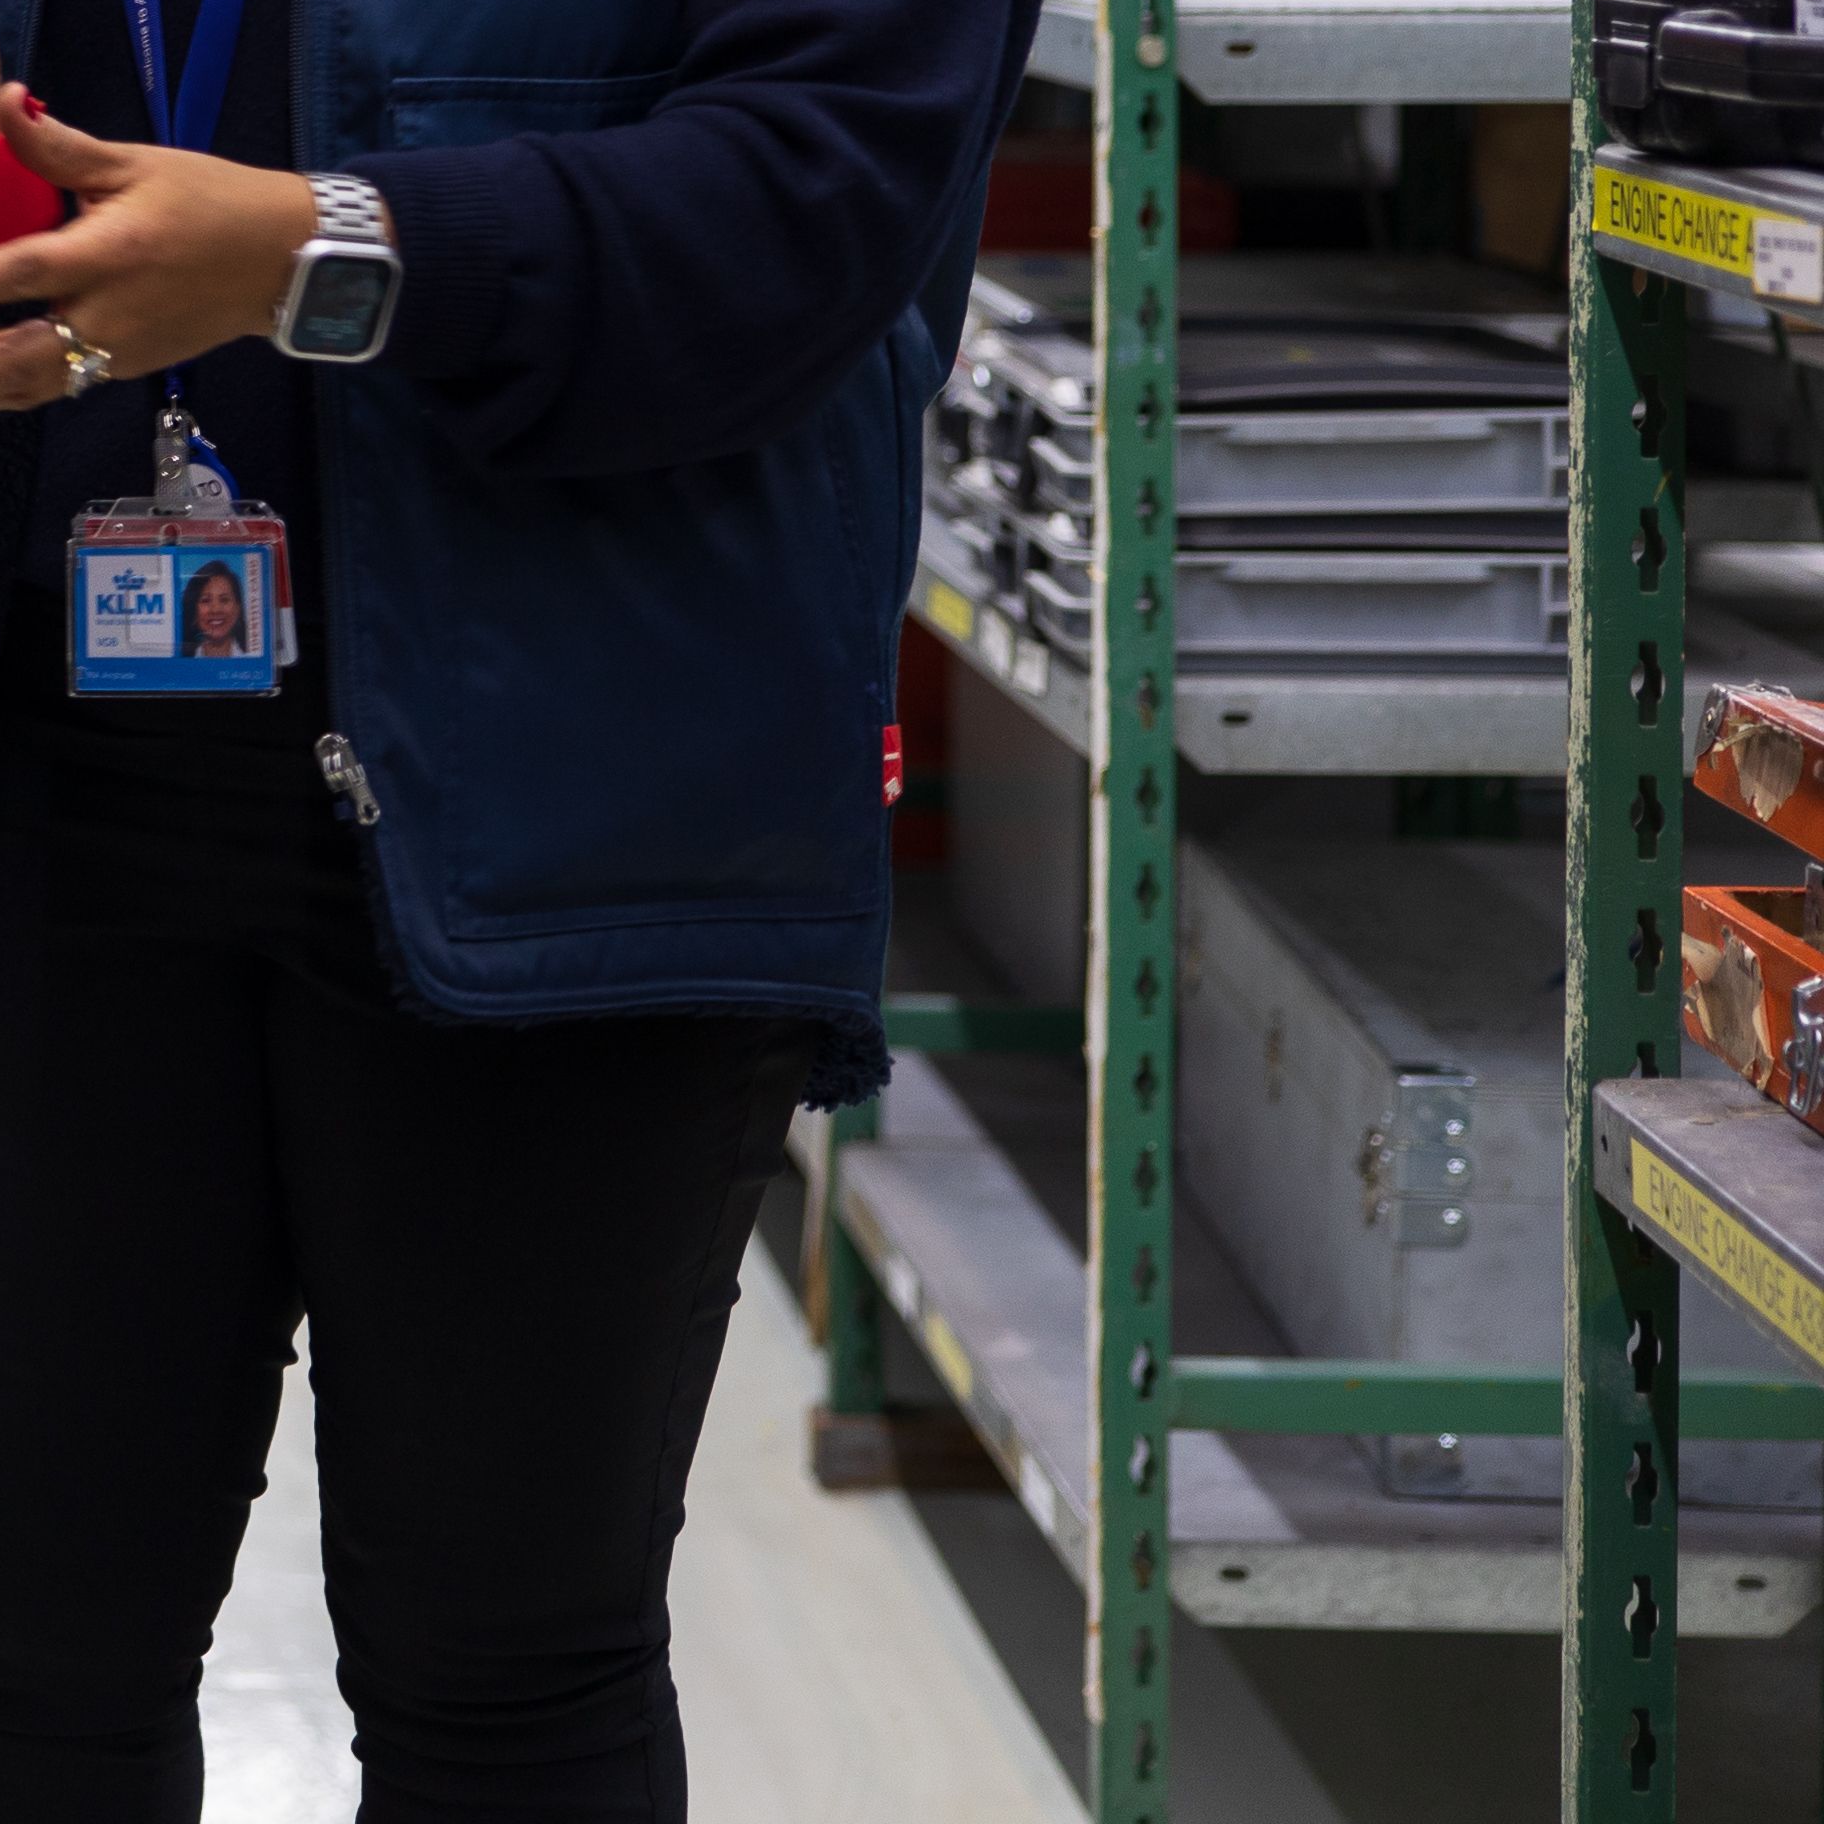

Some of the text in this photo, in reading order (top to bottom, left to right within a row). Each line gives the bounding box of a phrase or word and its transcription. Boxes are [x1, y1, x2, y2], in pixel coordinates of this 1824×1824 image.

[137, 7, 148, 24] to
[1611, 180, 1667, 242] ENGINE
[1671, 197, 1739, 263] CHANGE
[96, 593, 165, 615] KLM
[1649, 1162, 1709, 1256] ENGINE
[1713, 1217, 1786, 1320] CHANGE
